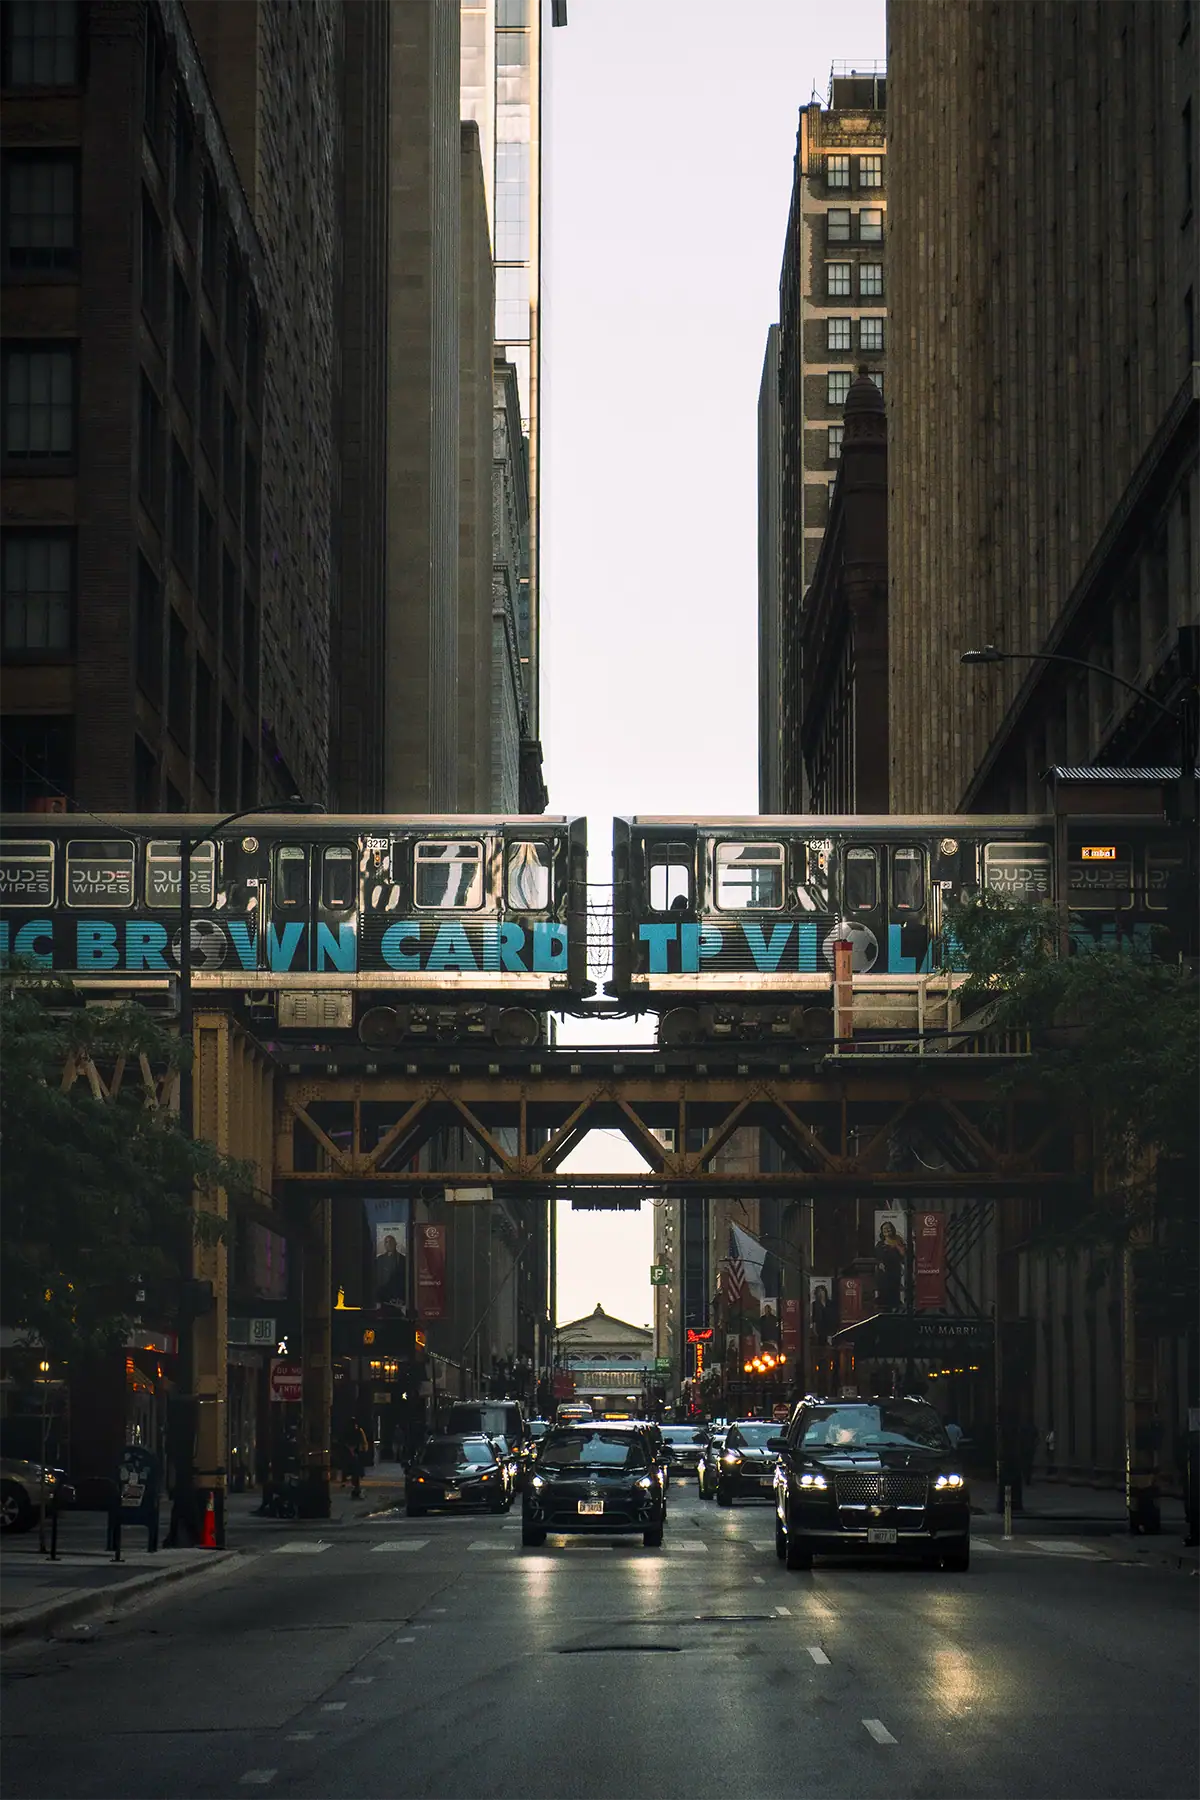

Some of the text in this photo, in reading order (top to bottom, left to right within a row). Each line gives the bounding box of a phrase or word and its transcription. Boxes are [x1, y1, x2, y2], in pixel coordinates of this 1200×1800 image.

[367, 839, 388, 849] 3212
[811, 840, 830, 850] 3211
[72, 870, 130, 883] DUDE
[990, 868, 1047, 881] DUDE
[72, 884, 130, 894] WIPES
[990, 882, 1047, 892] WIPES
[381, 920, 567, 972] CARD
[639, 923, 723, 973] TP
[917, 1325, 937, 1335] JW
